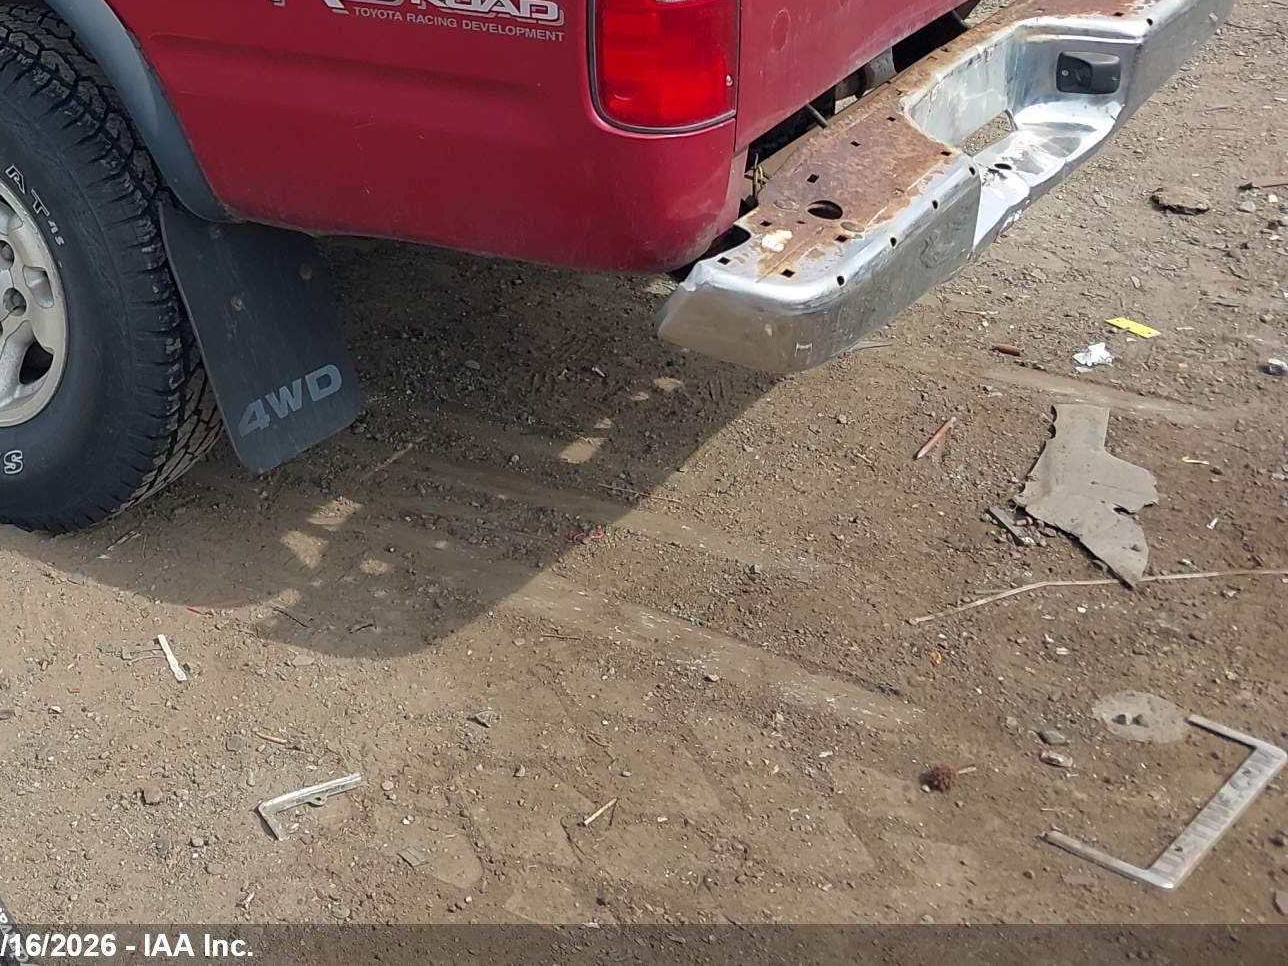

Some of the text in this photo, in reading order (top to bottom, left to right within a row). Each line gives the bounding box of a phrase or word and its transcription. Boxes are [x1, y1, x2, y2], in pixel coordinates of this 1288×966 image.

[353, 6, 566, 43] TOYOTA RACING DEVELOPMENT
[238, 363, 343, 438] 4WD
